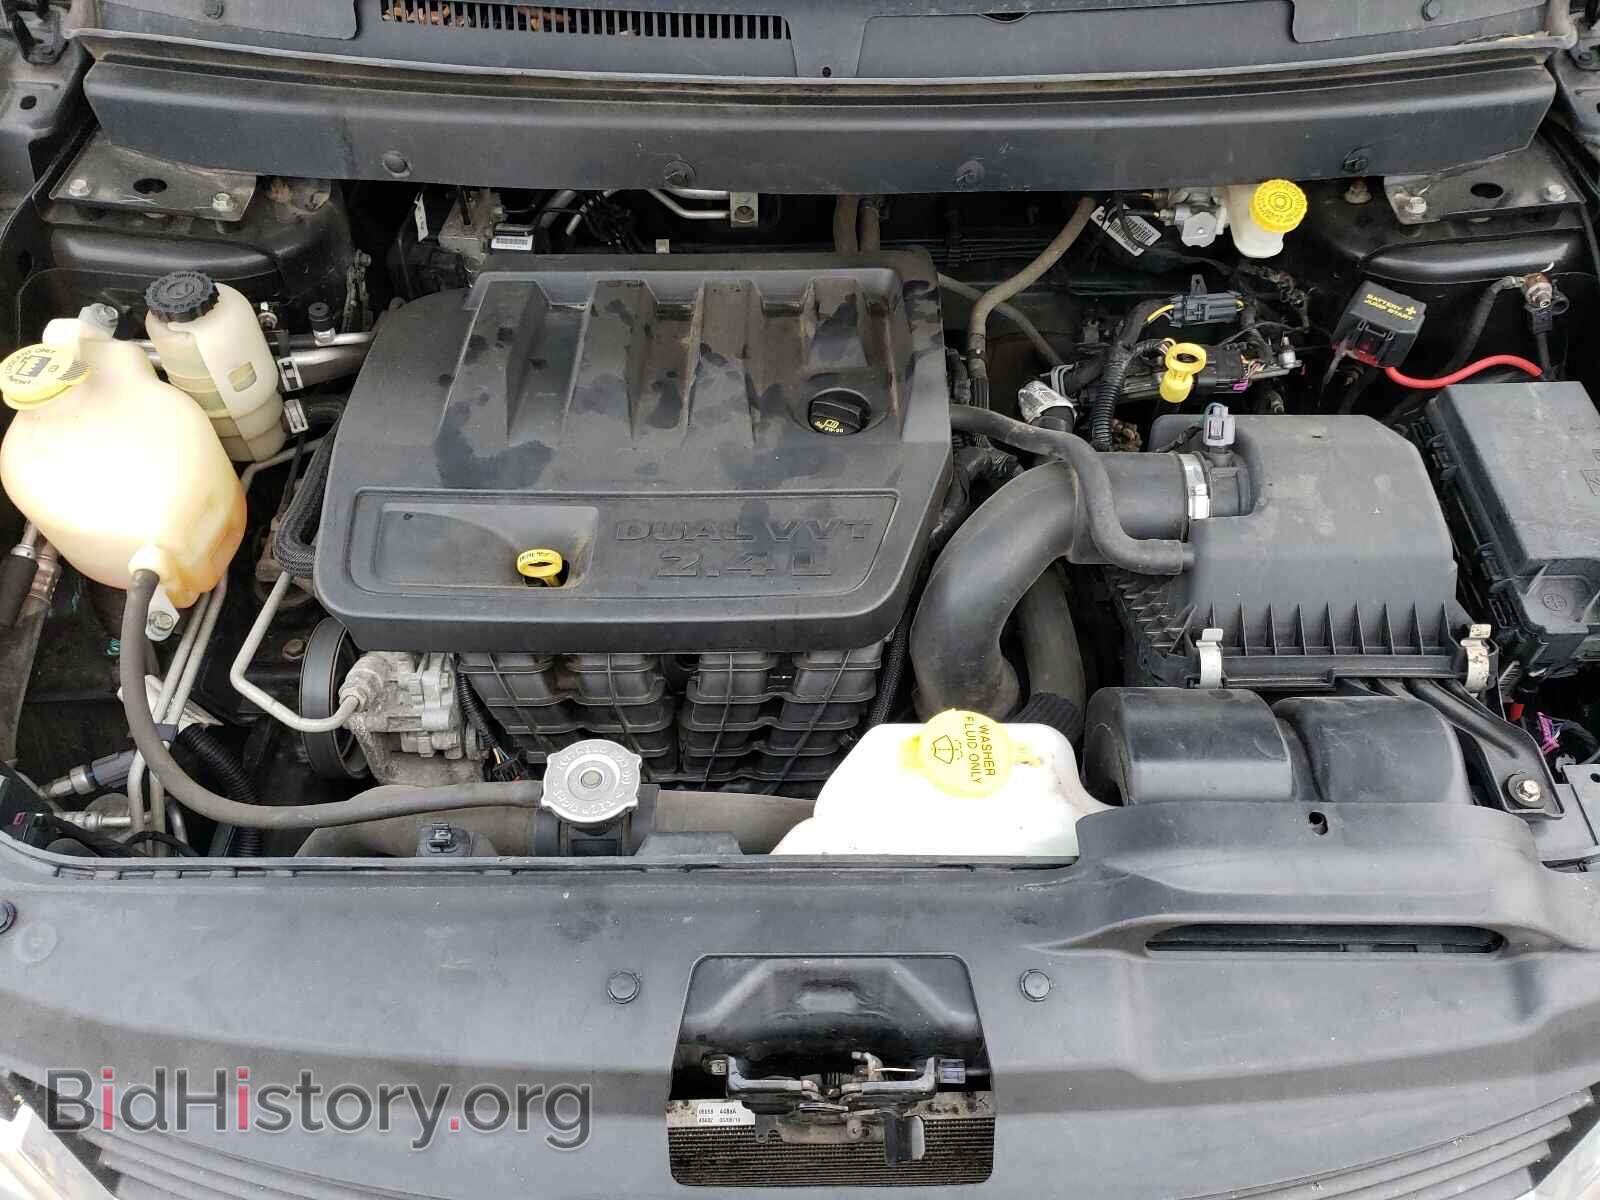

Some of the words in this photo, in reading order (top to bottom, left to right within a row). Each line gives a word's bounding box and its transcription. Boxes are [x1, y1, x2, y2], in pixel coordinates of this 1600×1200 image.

[1365, 293, 1402, 311] BATTERY
[1387, 307, 1414, 321] START
[615, 519, 754, 542] DUAL
[765, 519, 873, 543] VVT
[656, 550, 833, 577] 2.4L
[963, 715, 979, 751] FLUID
[978, 723, 997, 777] WASHER
[967, 752, 984, 784] ONLY
